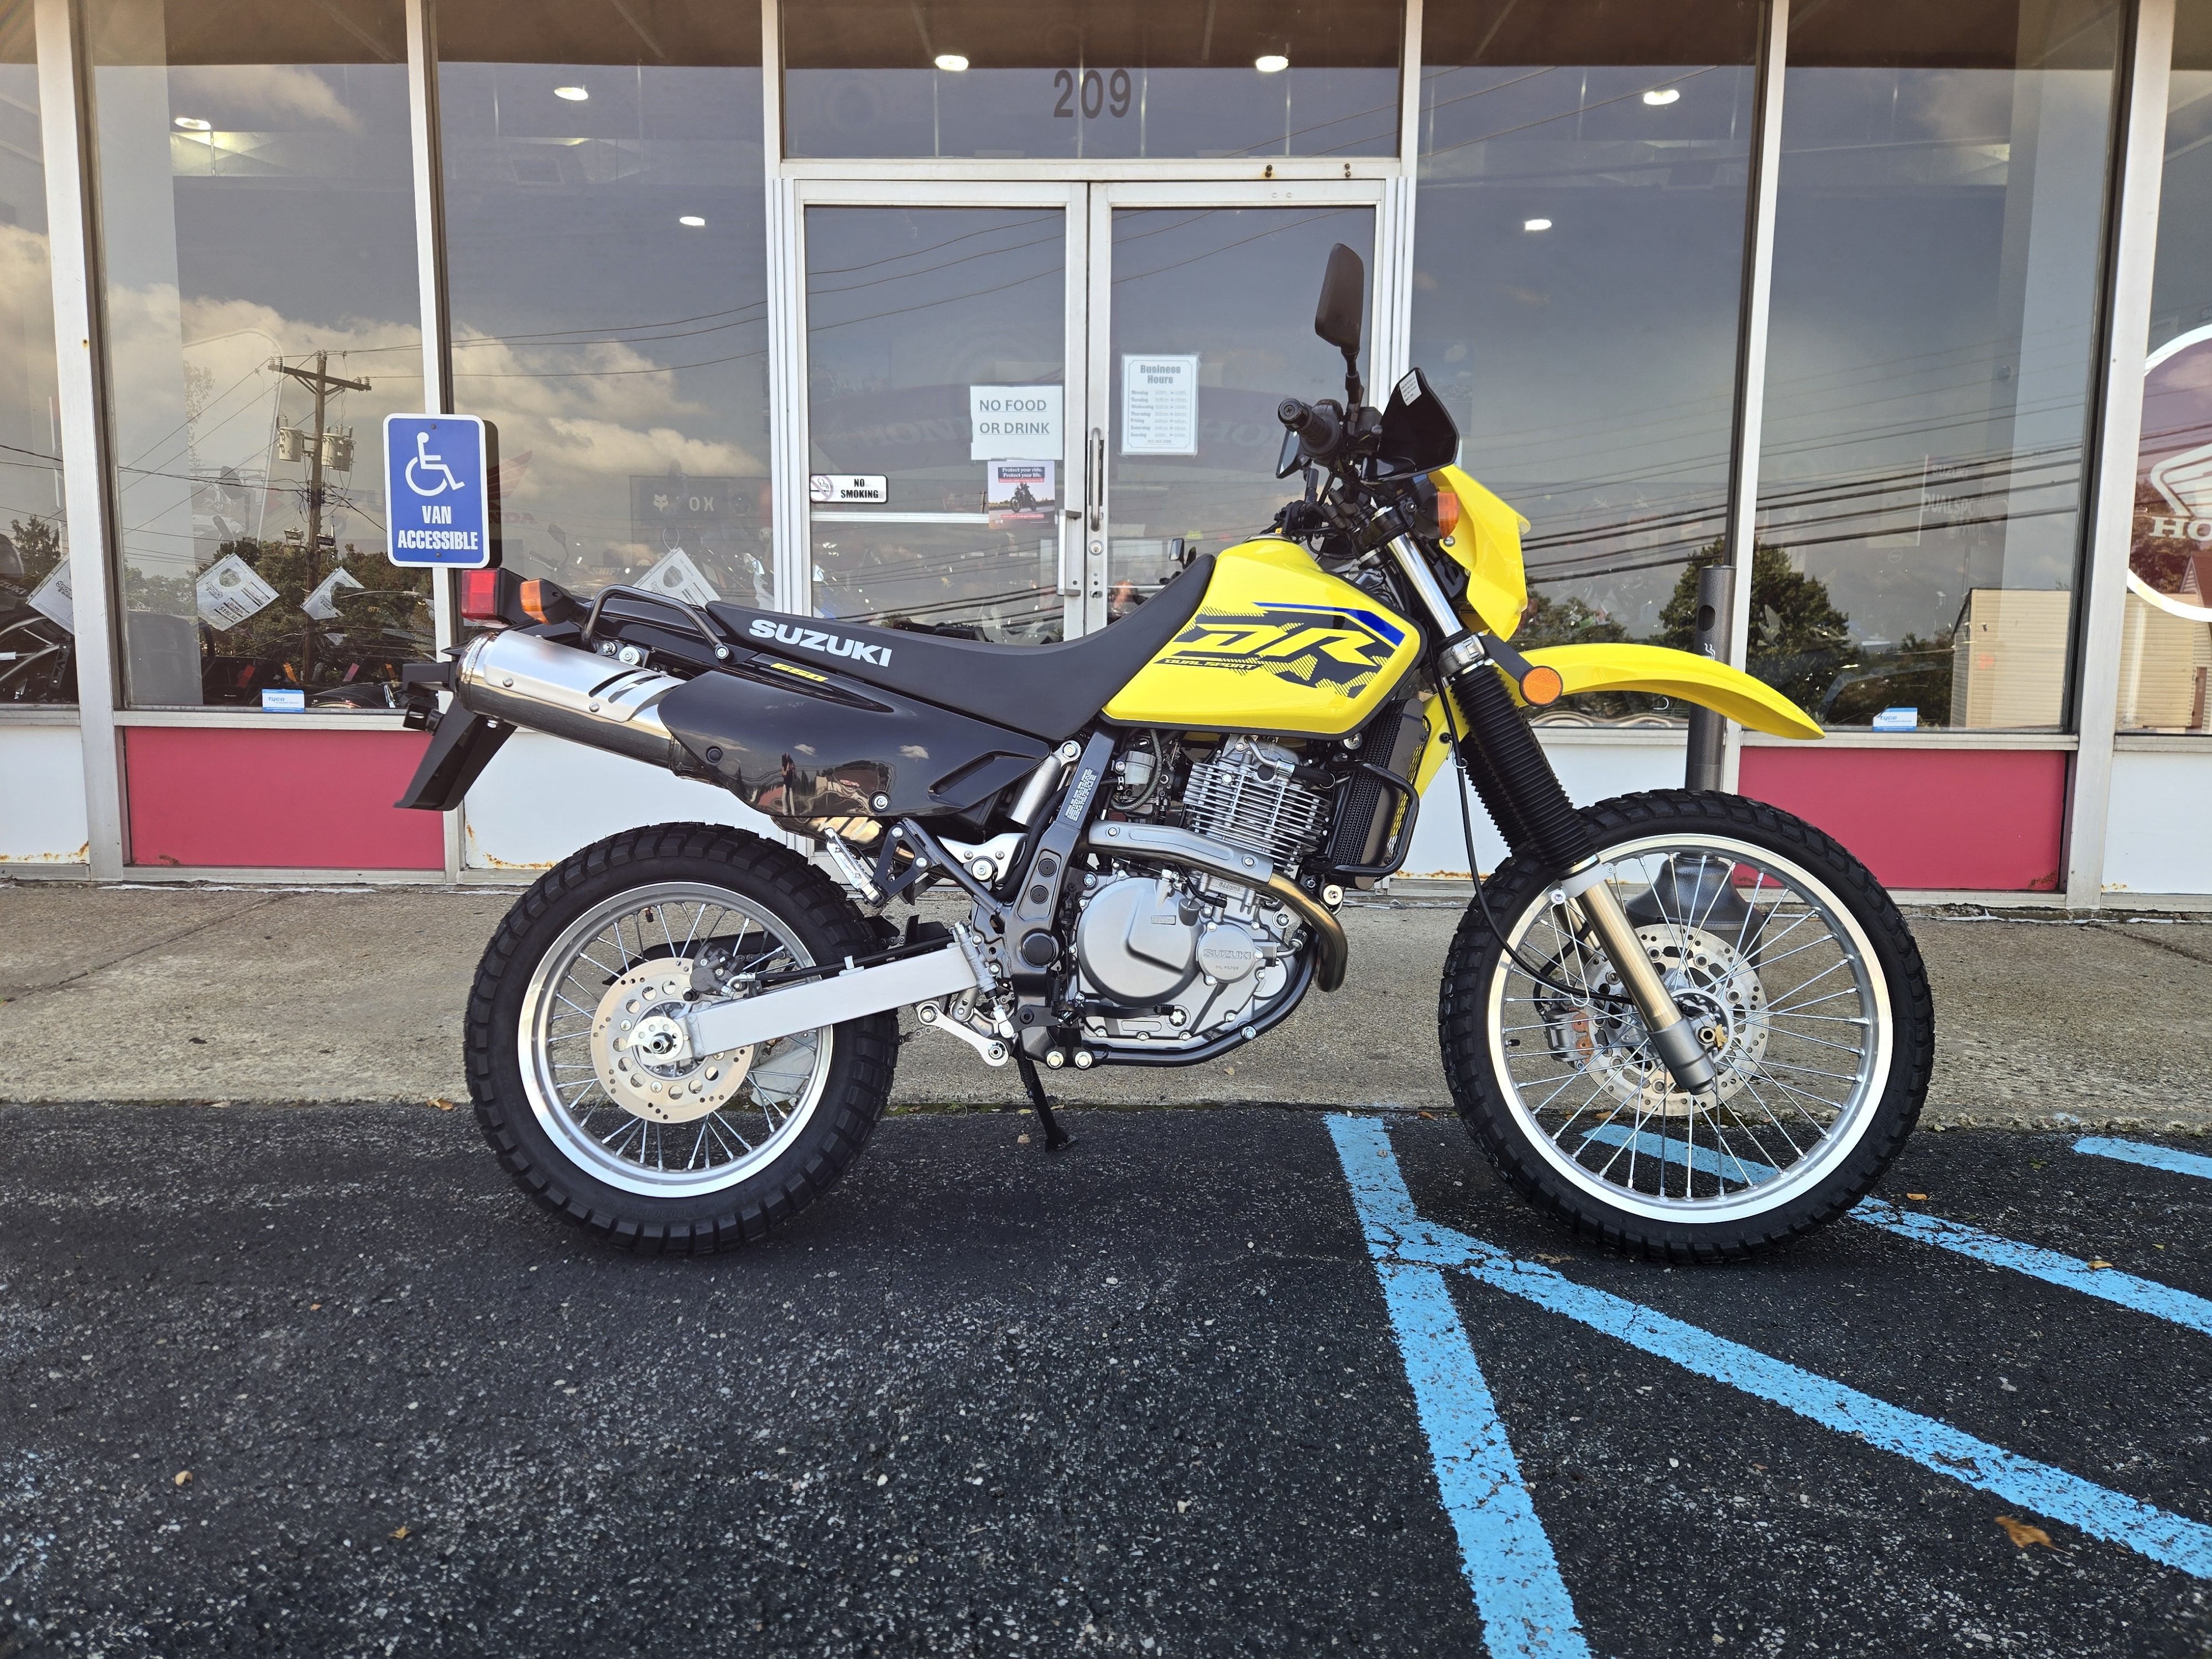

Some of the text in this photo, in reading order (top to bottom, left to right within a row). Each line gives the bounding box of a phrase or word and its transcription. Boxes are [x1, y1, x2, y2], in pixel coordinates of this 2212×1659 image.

[1053, 69, 1131, 119] 209
[1140, 365, 1181, 374] Business
[1147, 375, 1173, 384] Hours
[979, 399, 1047, 411] NO FOOD
[979, 422, 1050, 434] OR DRINK
[853, 478, 865, 488] NO
[840, 489, 879, 499] SMOKING
[421, 505, 452, 524] VAN
[398, 529, 478, 550] ACCESSIBLE
[56, 580, 72, 596] Snow
[749, 619, 892, 667] SUZUKI
[1172, 623, 1378, 666] DR
[1204, 661, 1256, 669] SPORT
[770, 663, 828, 682] 650
[1203, 948, 1251, 960] SUZUKI
